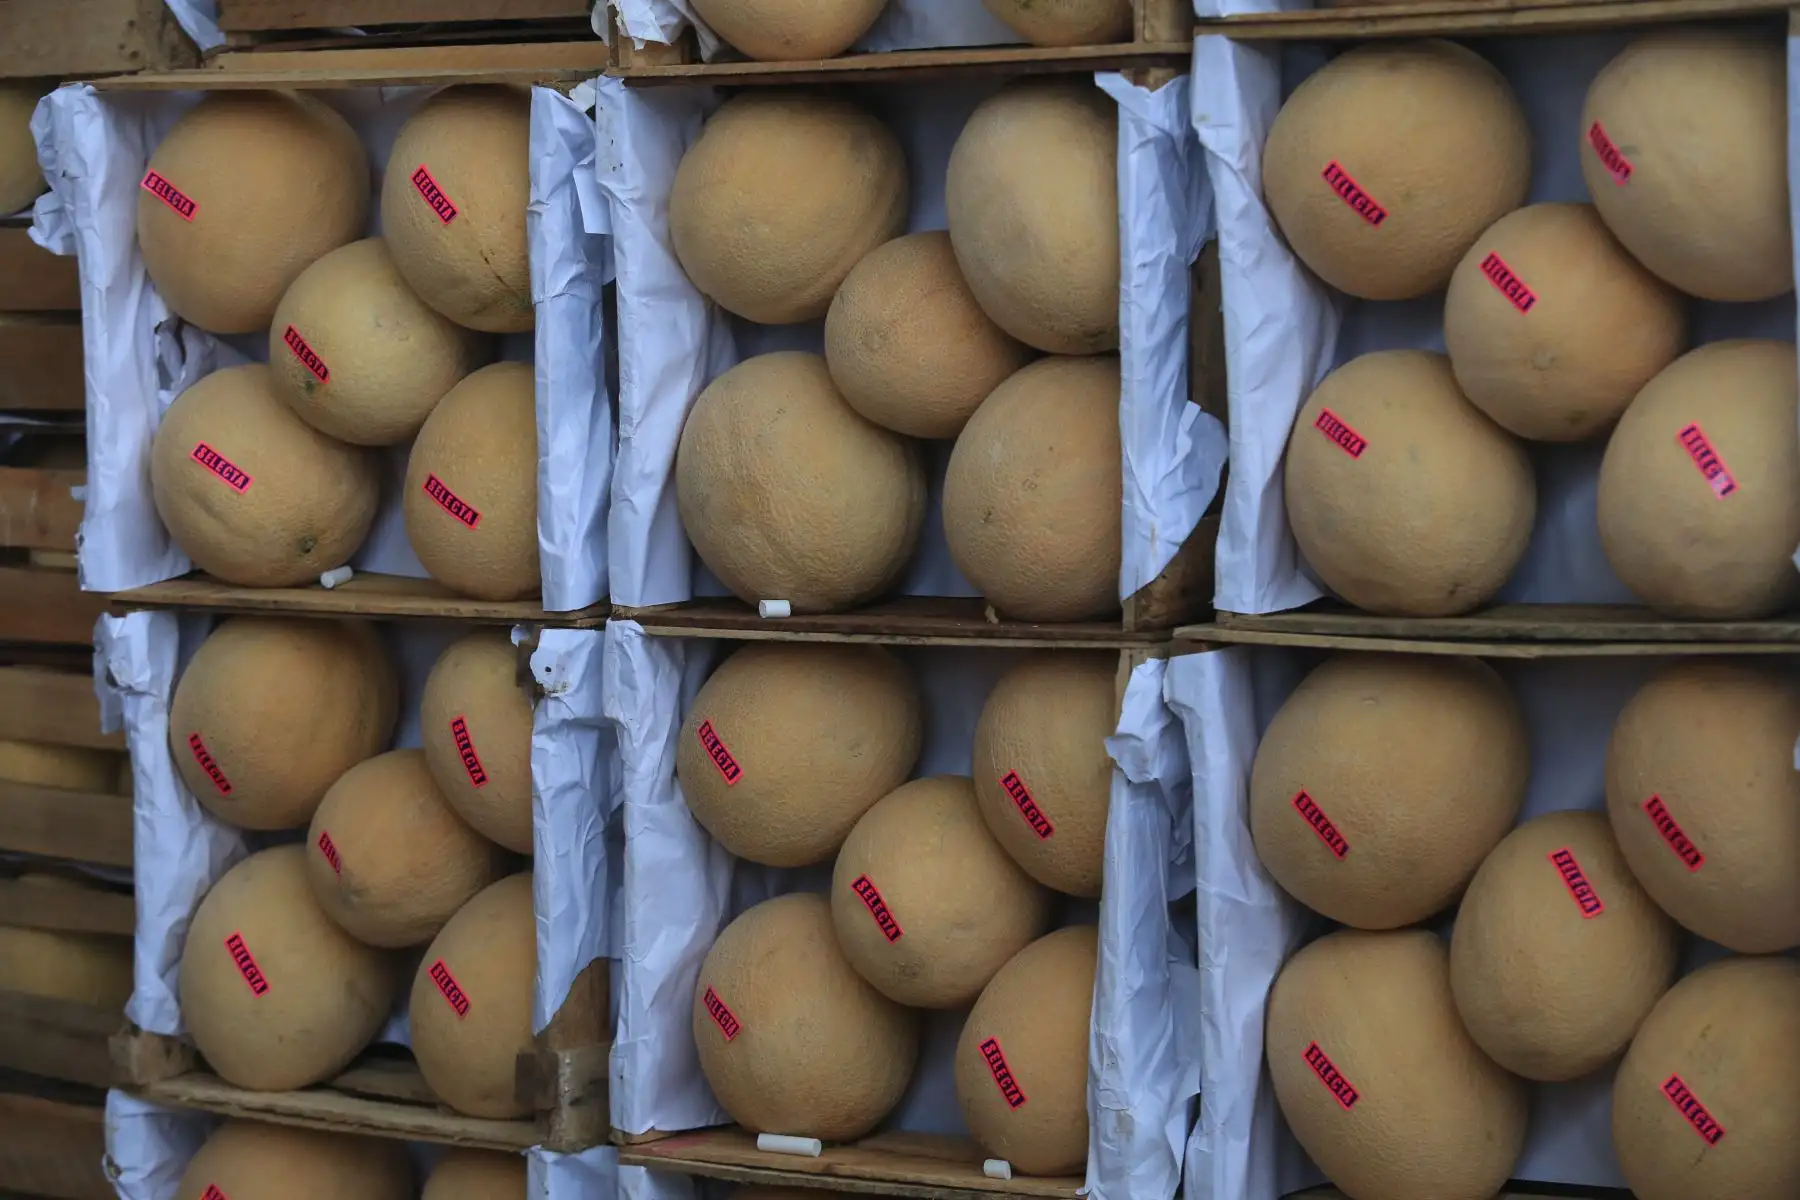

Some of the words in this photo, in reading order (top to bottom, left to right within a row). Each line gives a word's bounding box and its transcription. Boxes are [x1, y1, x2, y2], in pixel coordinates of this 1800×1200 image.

[146, 174, 193, 215] SELECTA
[414, 171, 454, 220] SELECTA
[286, 329, 326, 376] SELECTA
[1316, 414, 1361, 454] SELECTA
[197, 448, 246, 489] SELECTA
[427, 477, 472, 524] SELECTA
[452, 722, 485, 783] SELECTA
[700, 725, 738, 778] SELECTA
[1008, 777, 1047, 836] SELECTA
[1300, 796, 1346, 855] SELECTA
[858, 881, 900, 940] SELECTA
[228, 938, 266, 991] SELECTA
[432, 966, 468, 1013] SELECTA
[706, 995, 738, 1038] SELECTA
[985, 1044, 1021, 1106] SELECTA
[1310, 1050, 1356, 1105] SELECTA
